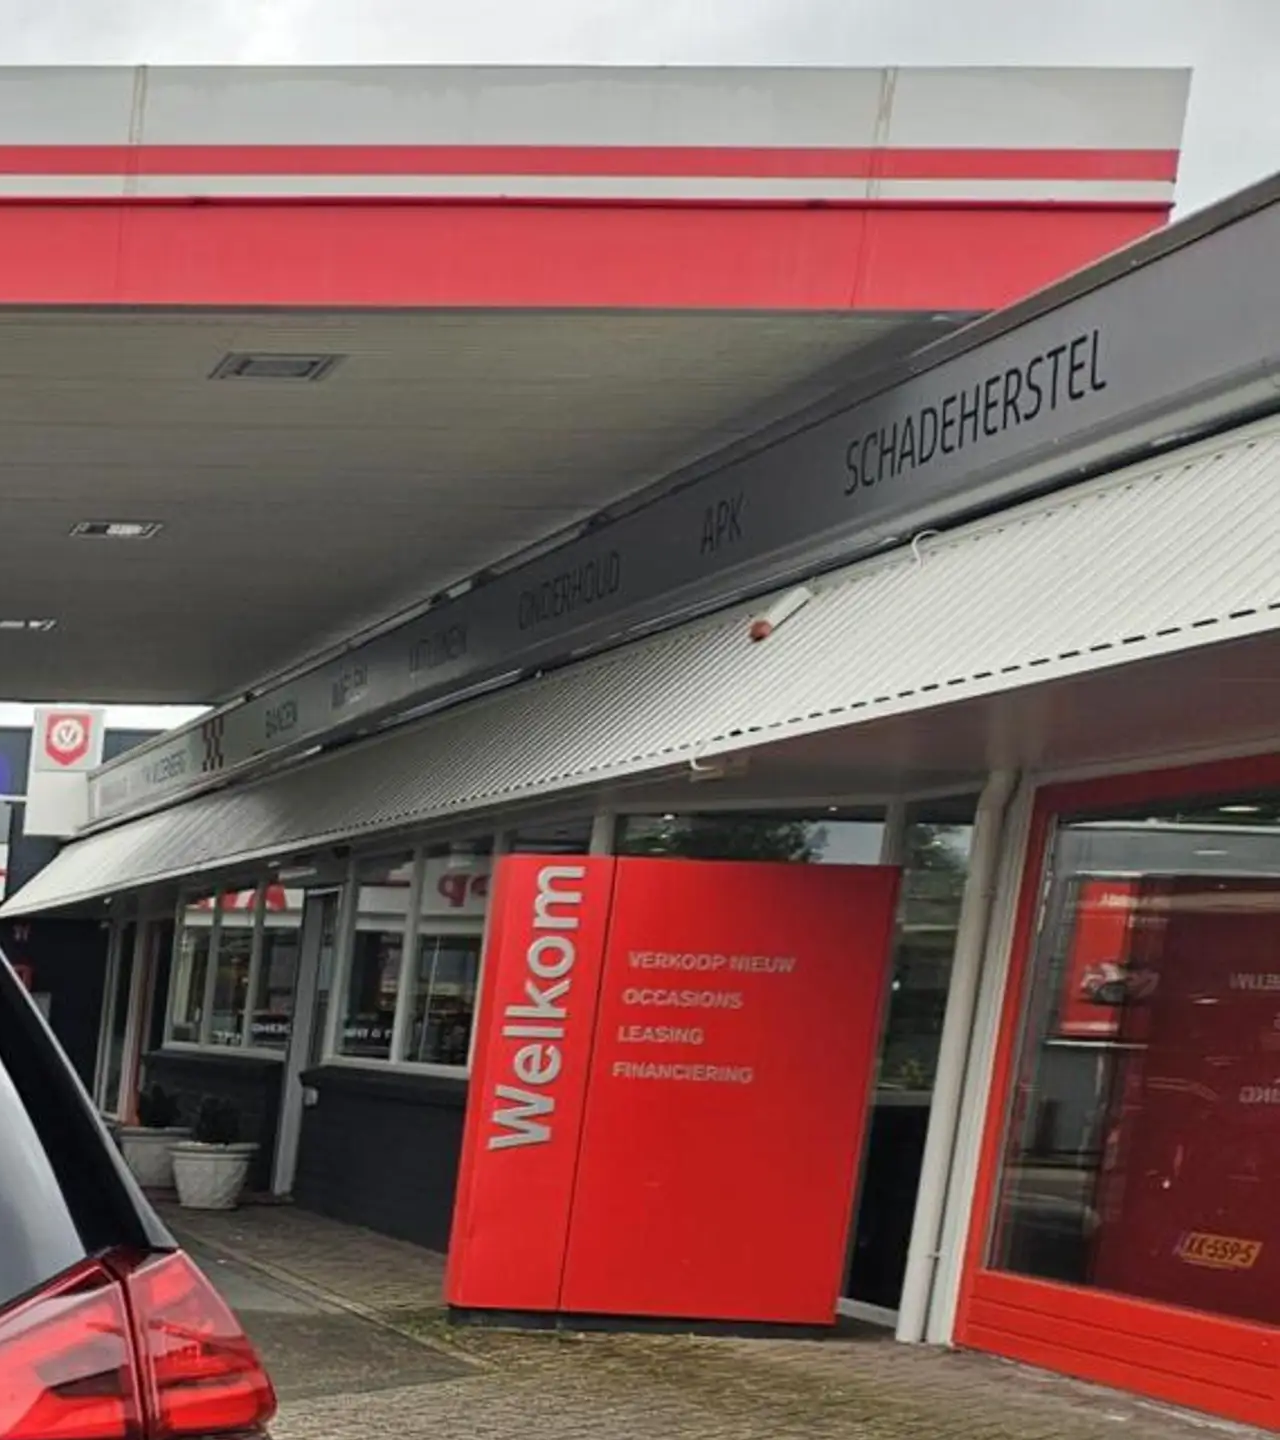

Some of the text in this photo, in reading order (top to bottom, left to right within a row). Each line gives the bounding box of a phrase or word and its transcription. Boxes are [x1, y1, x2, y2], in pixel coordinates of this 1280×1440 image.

[844, 330, 1107, 496] SCHADEHERSTEL
[700, 492, 749, 555] APK
[629, 952, 797, 974] VERKOOP NIEUW
[487, 865, 587, 1151] Welkom
[622, 989, 744, 1010] OCCASIONS
[618, 1026, 705, 1046] LEASING
[612, 1061, 755, 1084] FINANCIERING
